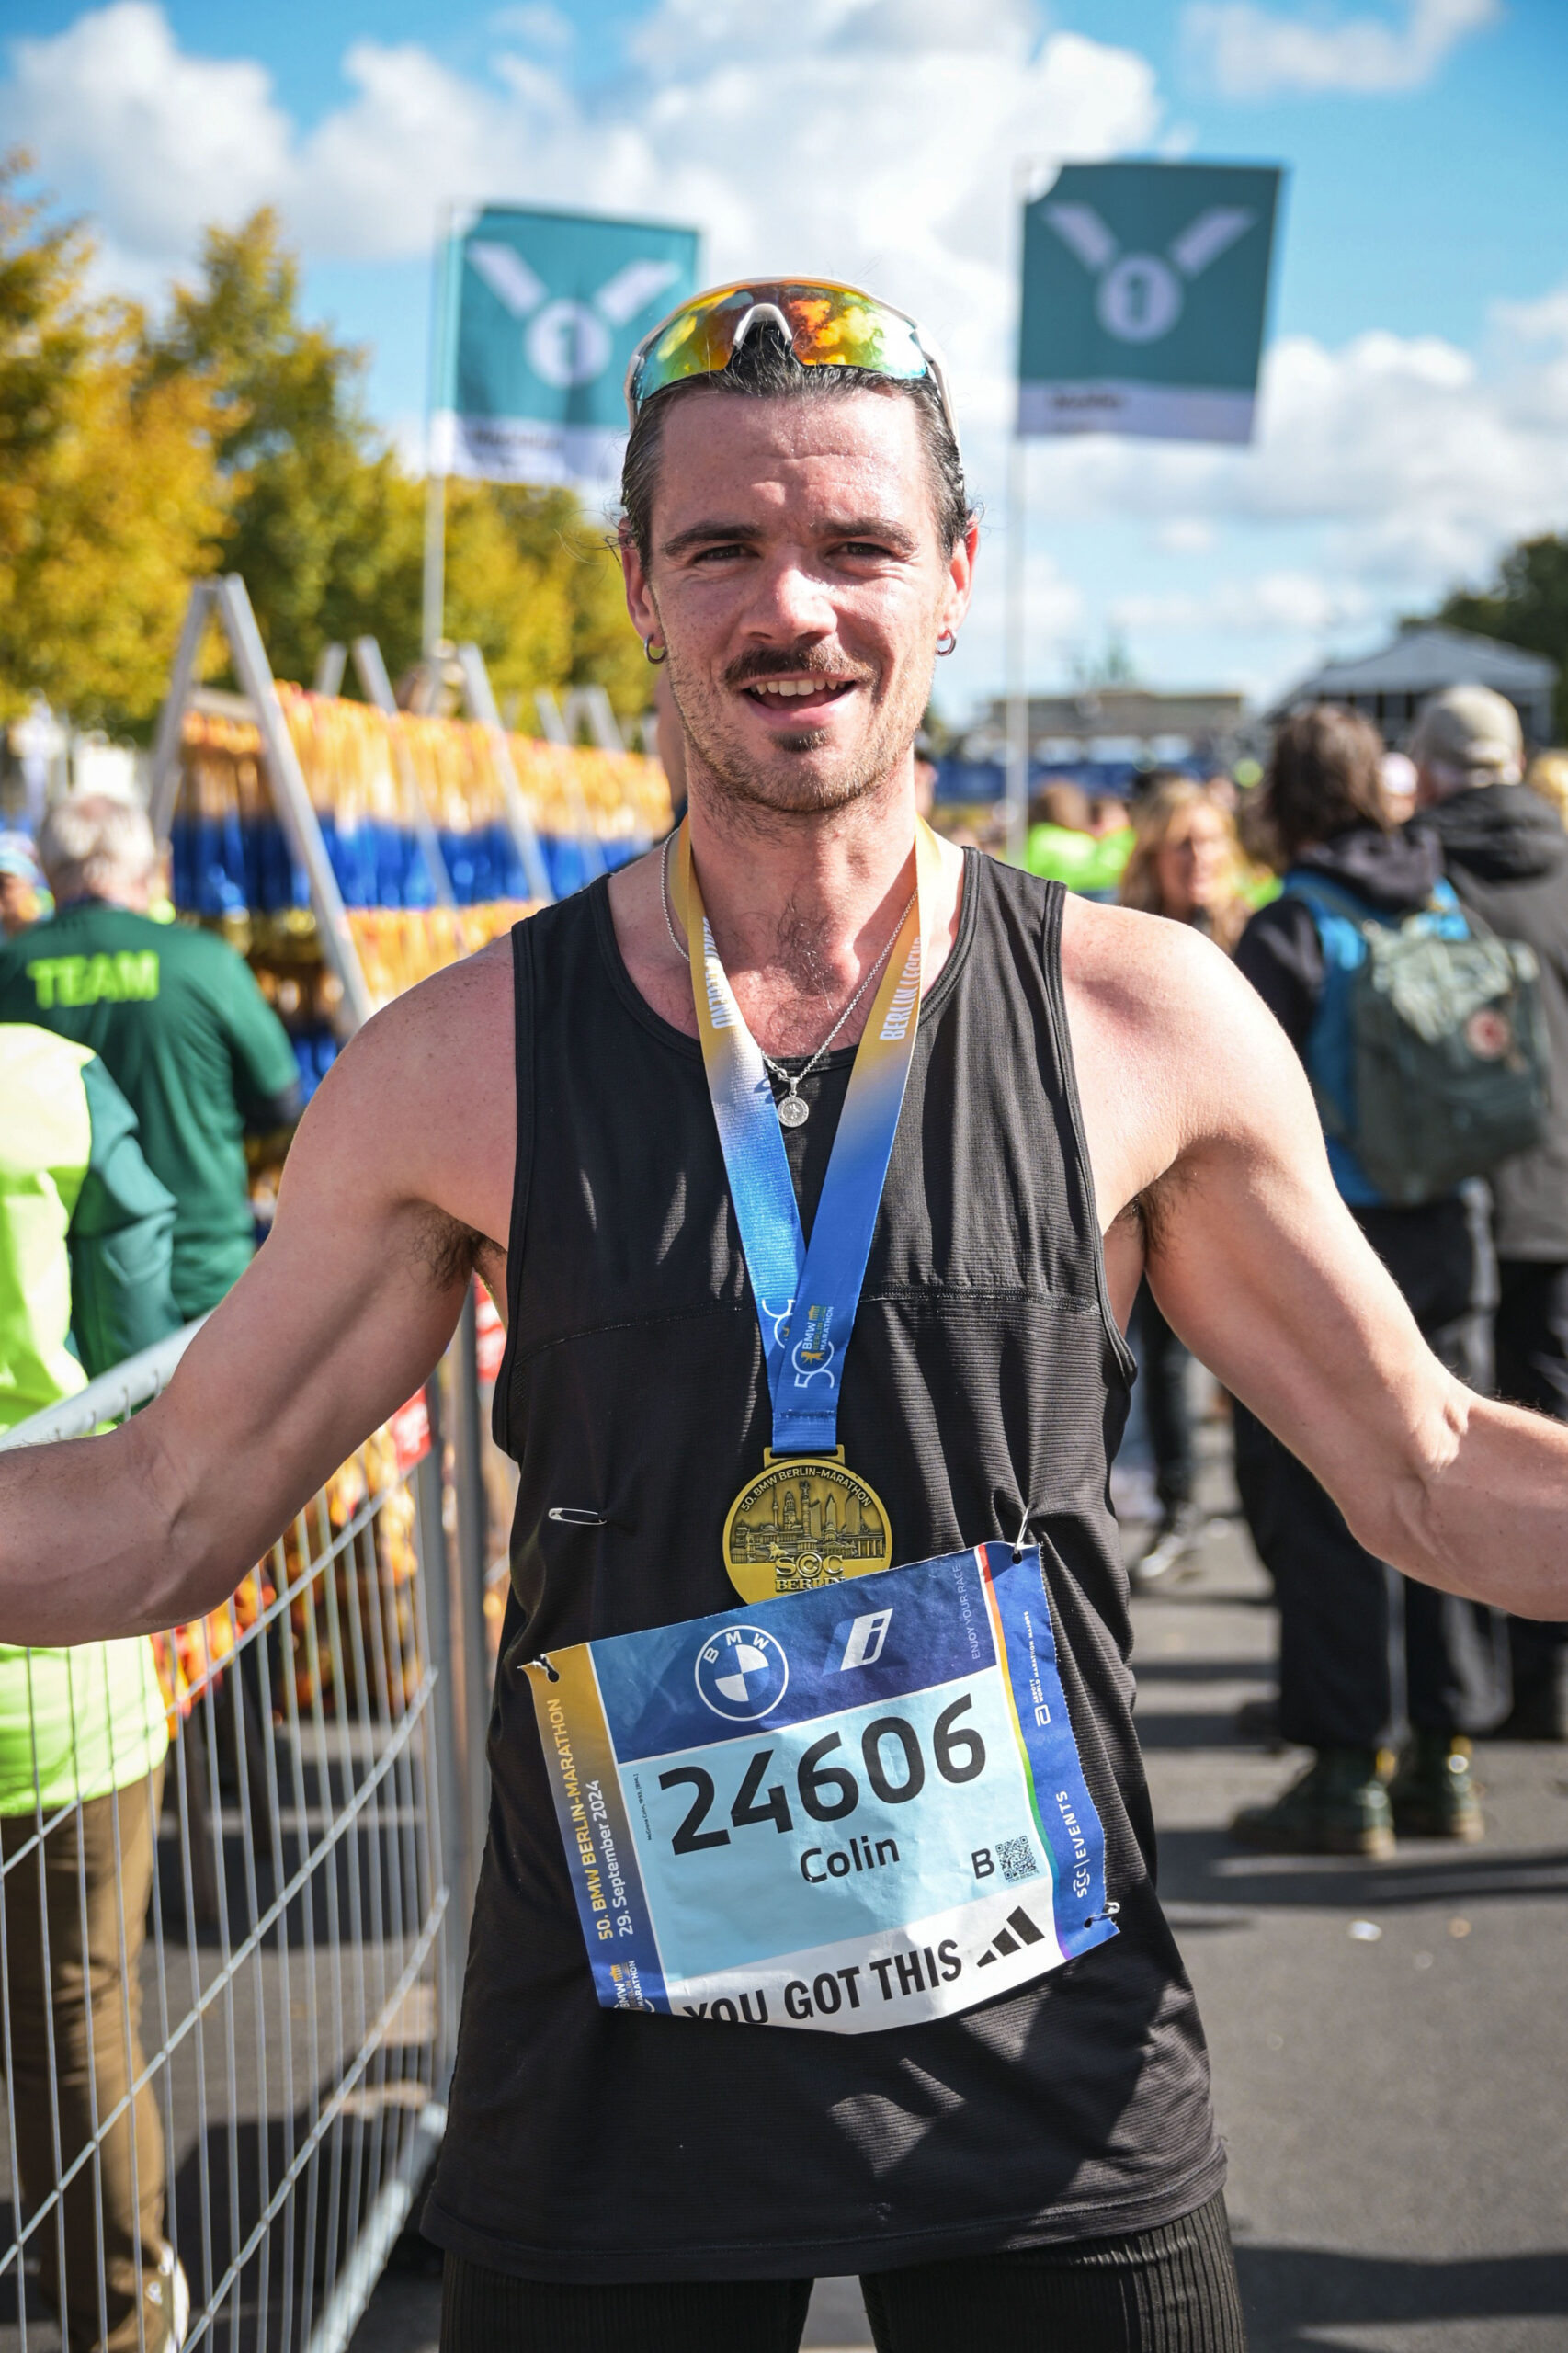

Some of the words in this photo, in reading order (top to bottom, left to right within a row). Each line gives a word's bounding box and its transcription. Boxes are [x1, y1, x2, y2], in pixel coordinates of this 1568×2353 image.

[28, 949, 159, 1009] TEAM
[880, 986, 918, 1040] BERLIN
[819, 1306, 835, 1351] MARATHON
[741, 1495, 756, 1511] 50.
[754, 1475, 778, 1497] BMW
[778, 1467, 872, 1507] BERLIN-MARATHON
[952, 1563, 967, 1594] RACE
[960, 1594, 973, 1626] YOUR
[1023, 1610, 1033, 1638] MAJORS
[703, 1631, 769, 1665] BMW
[966, 1627, 981, 1660] ENJOY
[1029, 1640, 1039, 1677] MARATHON
[1035, 1678, 1044, 1703] WORLD
[547, 1699, 597, 1866] BERLIN-MARATHON
[658, 1693, 986, 1856] 24606
[585, 1779, 608, 1822] 2024
[1056, 1790, 1087, 1859] EVENTS
[598, 1823, 628, 1908] September
[801, 1835, 900, 1884] Colin
[971, 1848, 995, 1880] B
[584, 1869, 607, 1912] BMW
[596, 1914, 614, 1941] 50.
[616, 1910, 634, 1938] 29.
[614, 1983, 630, 2008] BMW
[628, 1960, 644, 2007] MARATHON
[683, 1989, 769, 2024] YOU
[784, 1966, 860, 2019] GOT
[869, 1939, 962, 2001] THIS
